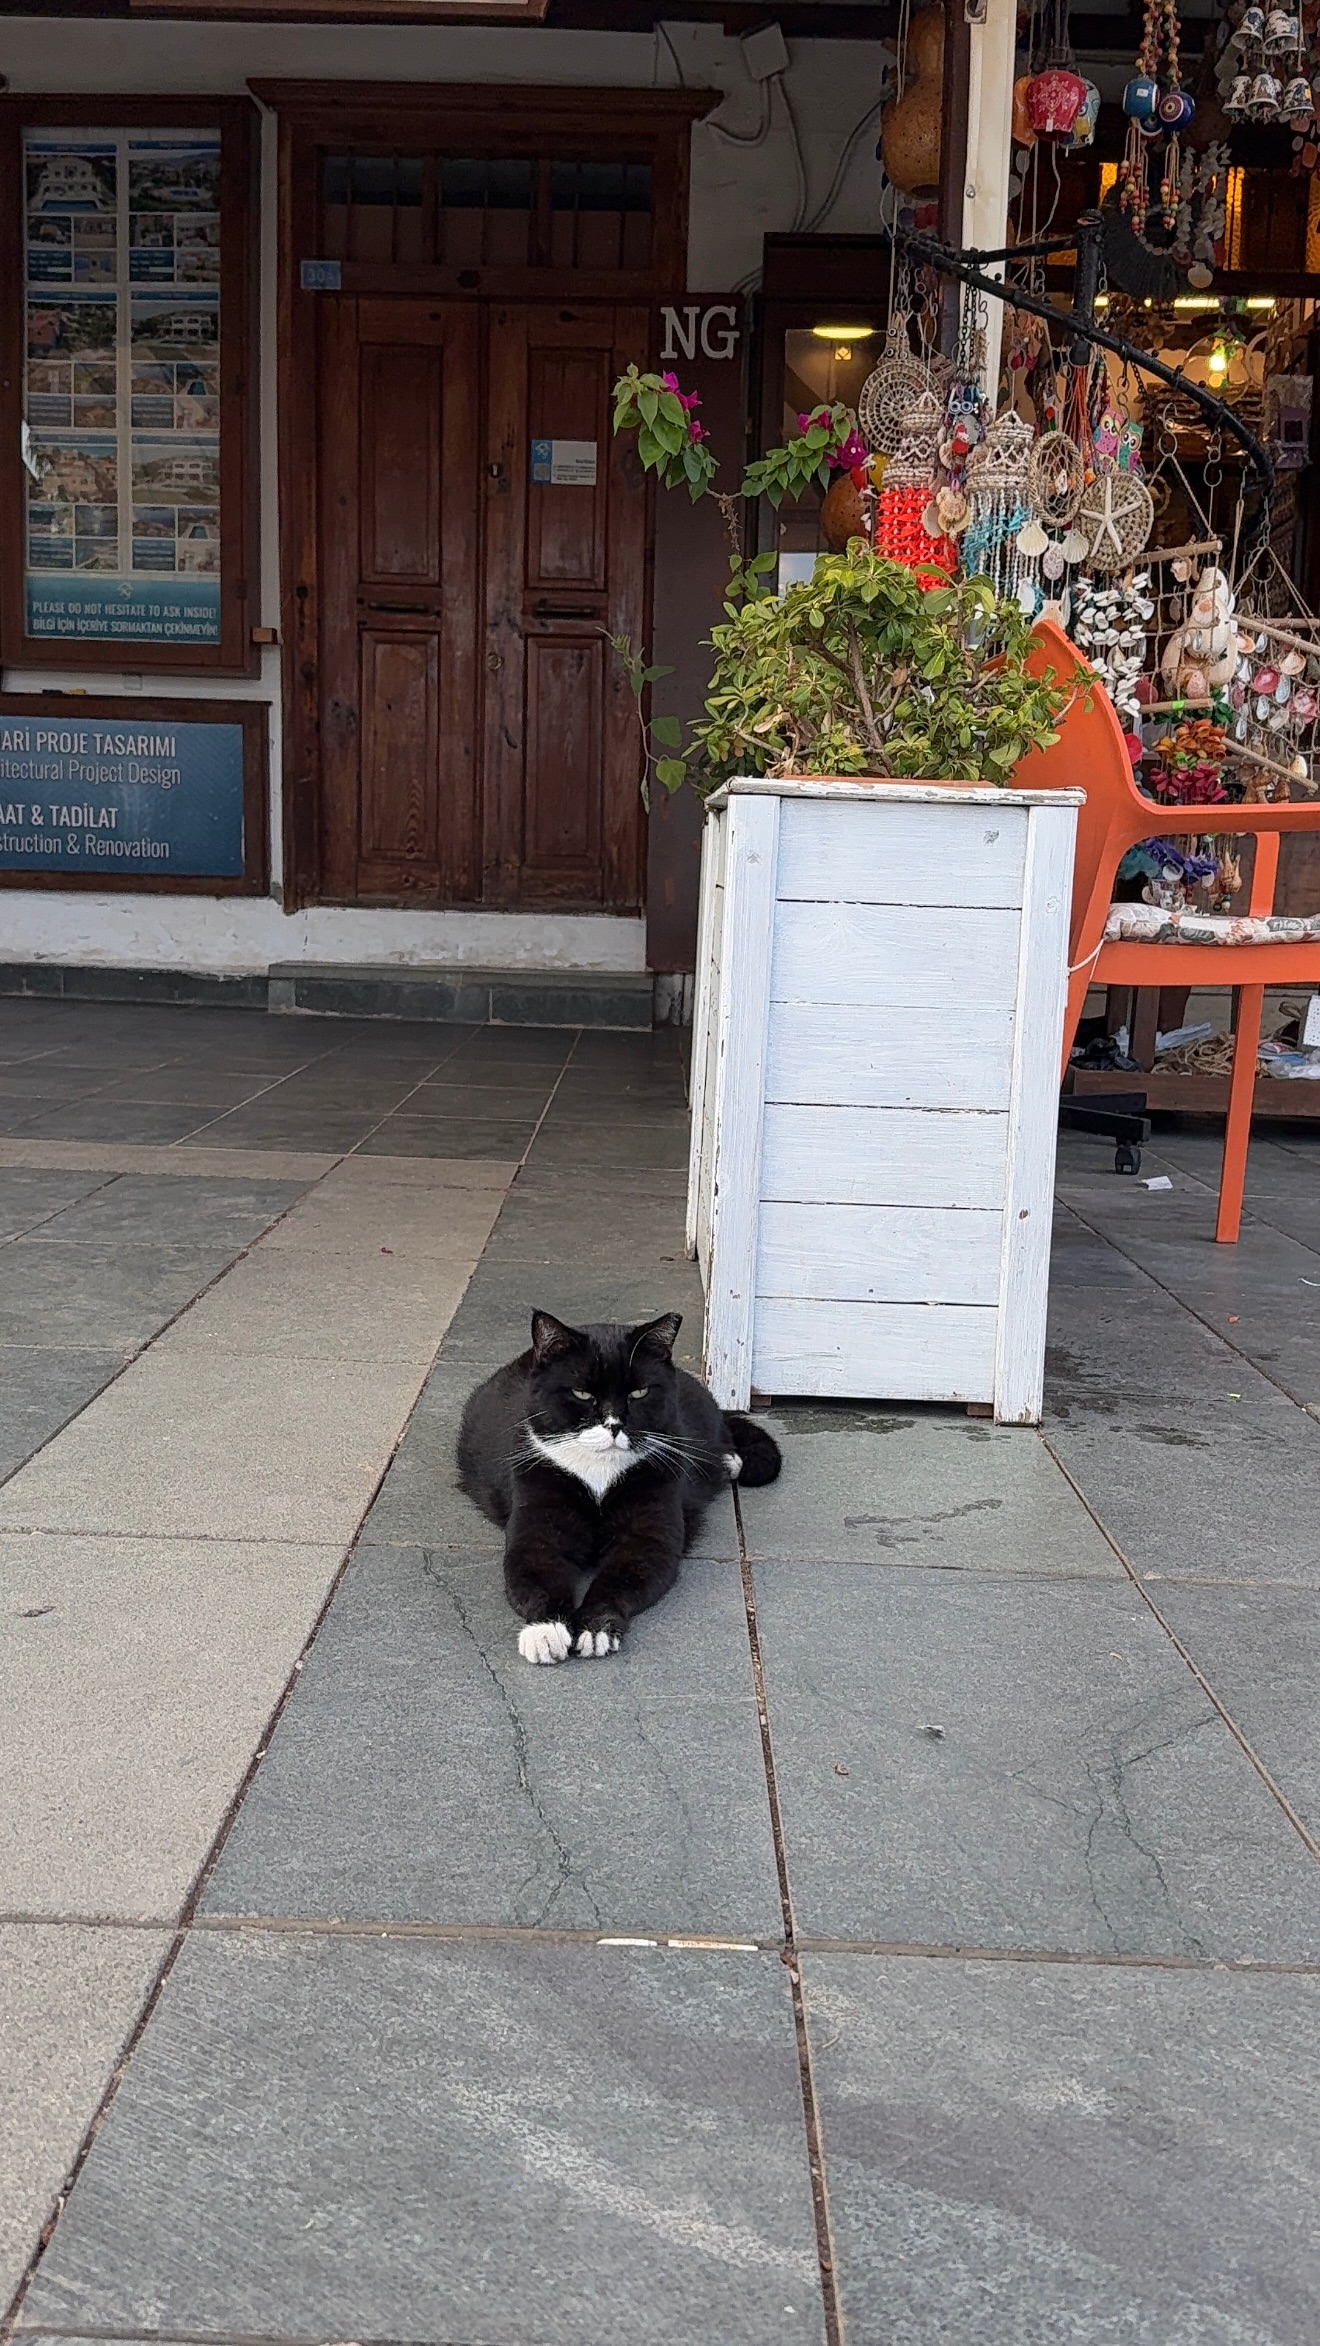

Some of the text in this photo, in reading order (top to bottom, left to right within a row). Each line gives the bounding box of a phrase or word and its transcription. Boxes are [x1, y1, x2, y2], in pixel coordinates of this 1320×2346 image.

[660, 305, 740, 360] NG
[32, 601, 65, 614] PLEASE
[68, 602, 81, 615] DO
[84, 603, 102, 615] NOT
[104, 603, 146, 616] HESITATE
[149, 604, 160, 617] TO
[163, 605, 180, 617] ASK
[32, 617, 56, 631] BİLGİ
[57, 617, 75, 633] İÇİN
[111, 621, 163, 634] SORMAKTAN
[36, 731, 88, 755] PROJE
[93, 733, 176, 758] TASARIMI
[69, 760, 123, 785] Project
[128, 762, 181, 788] Design
[31, 804, 44, 826] &
[49, 802, 118, 829] TADİLAT
[67, 833, 80, 855] &
[85, 834, 170, 859] Renovation
